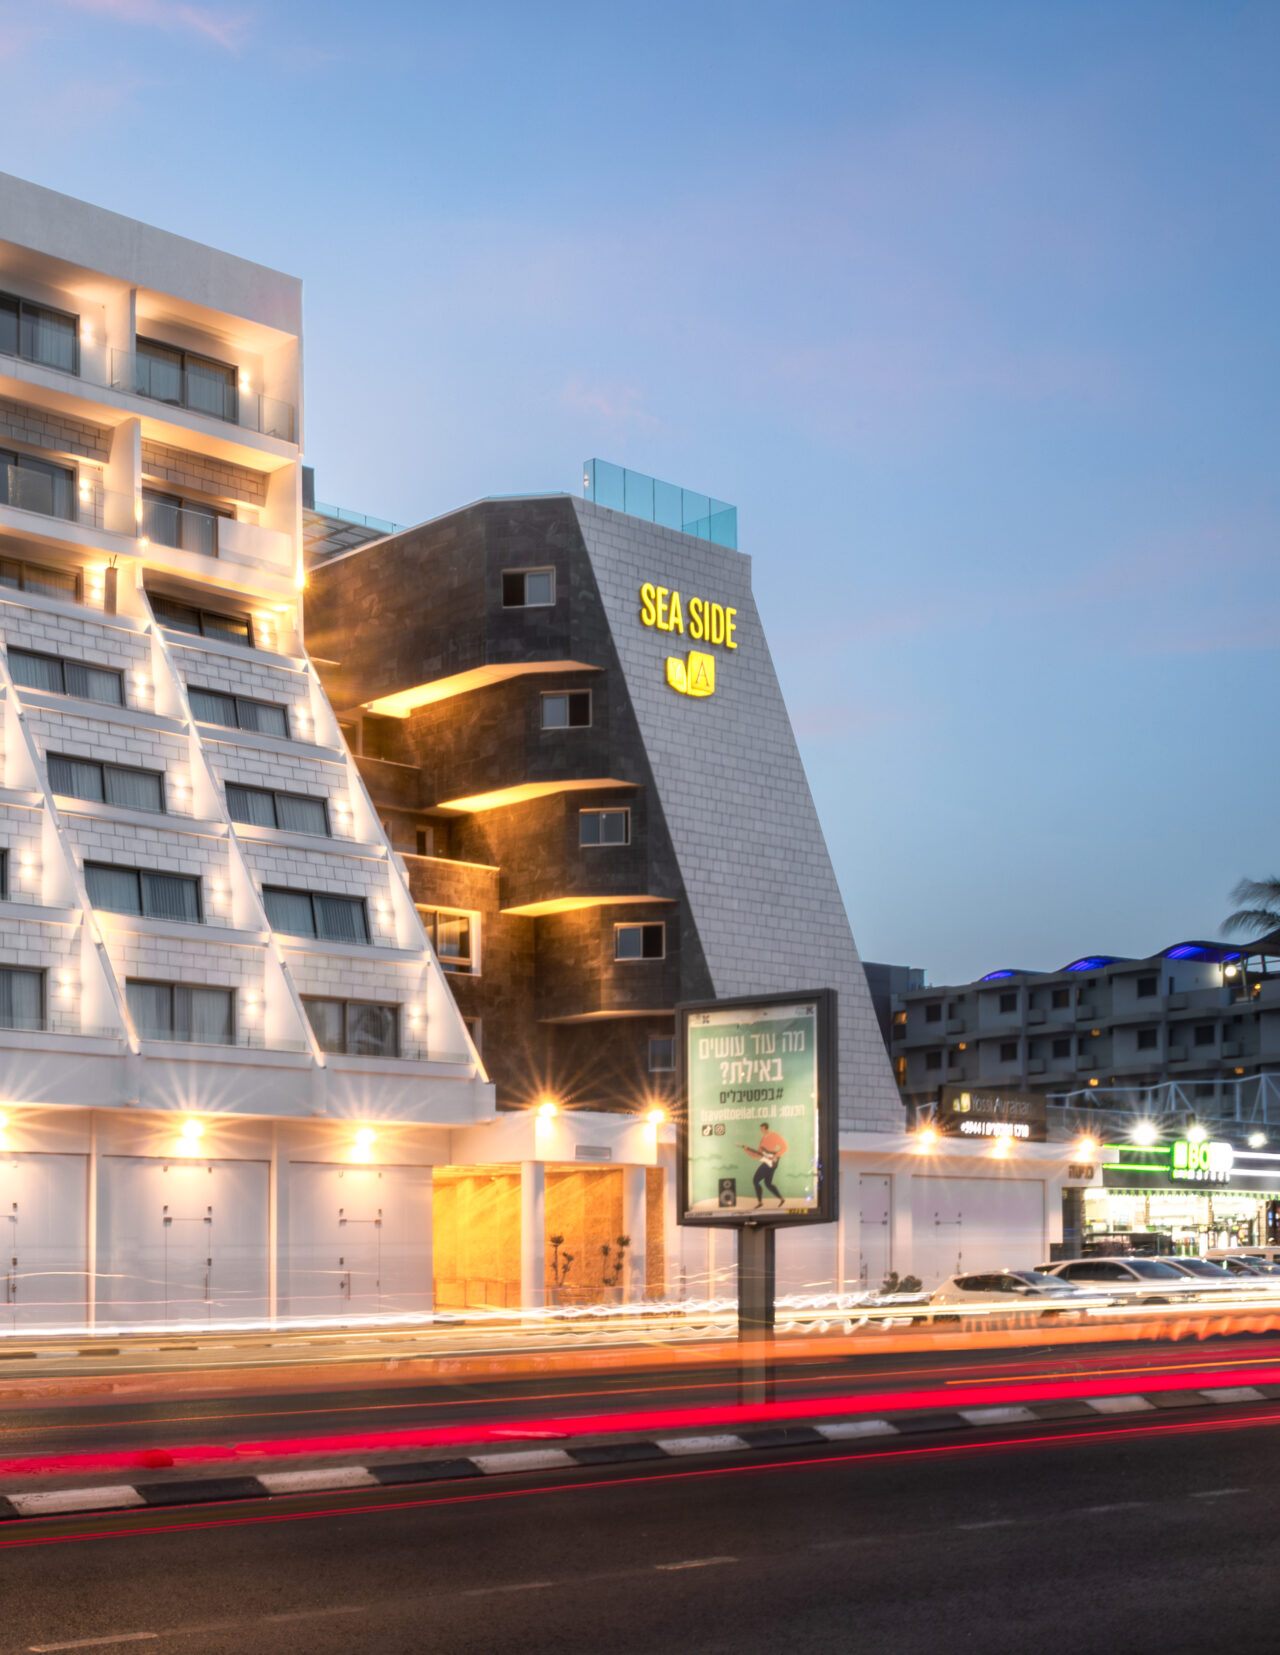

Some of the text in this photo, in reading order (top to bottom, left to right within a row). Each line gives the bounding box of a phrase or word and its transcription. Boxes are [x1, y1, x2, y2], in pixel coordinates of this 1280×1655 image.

[640, 582, 738, 649] SEA SIDE
[699, 1030, 805, 1060] מה עוד עושים
[720, 1057, 784, 1085] באילת?
